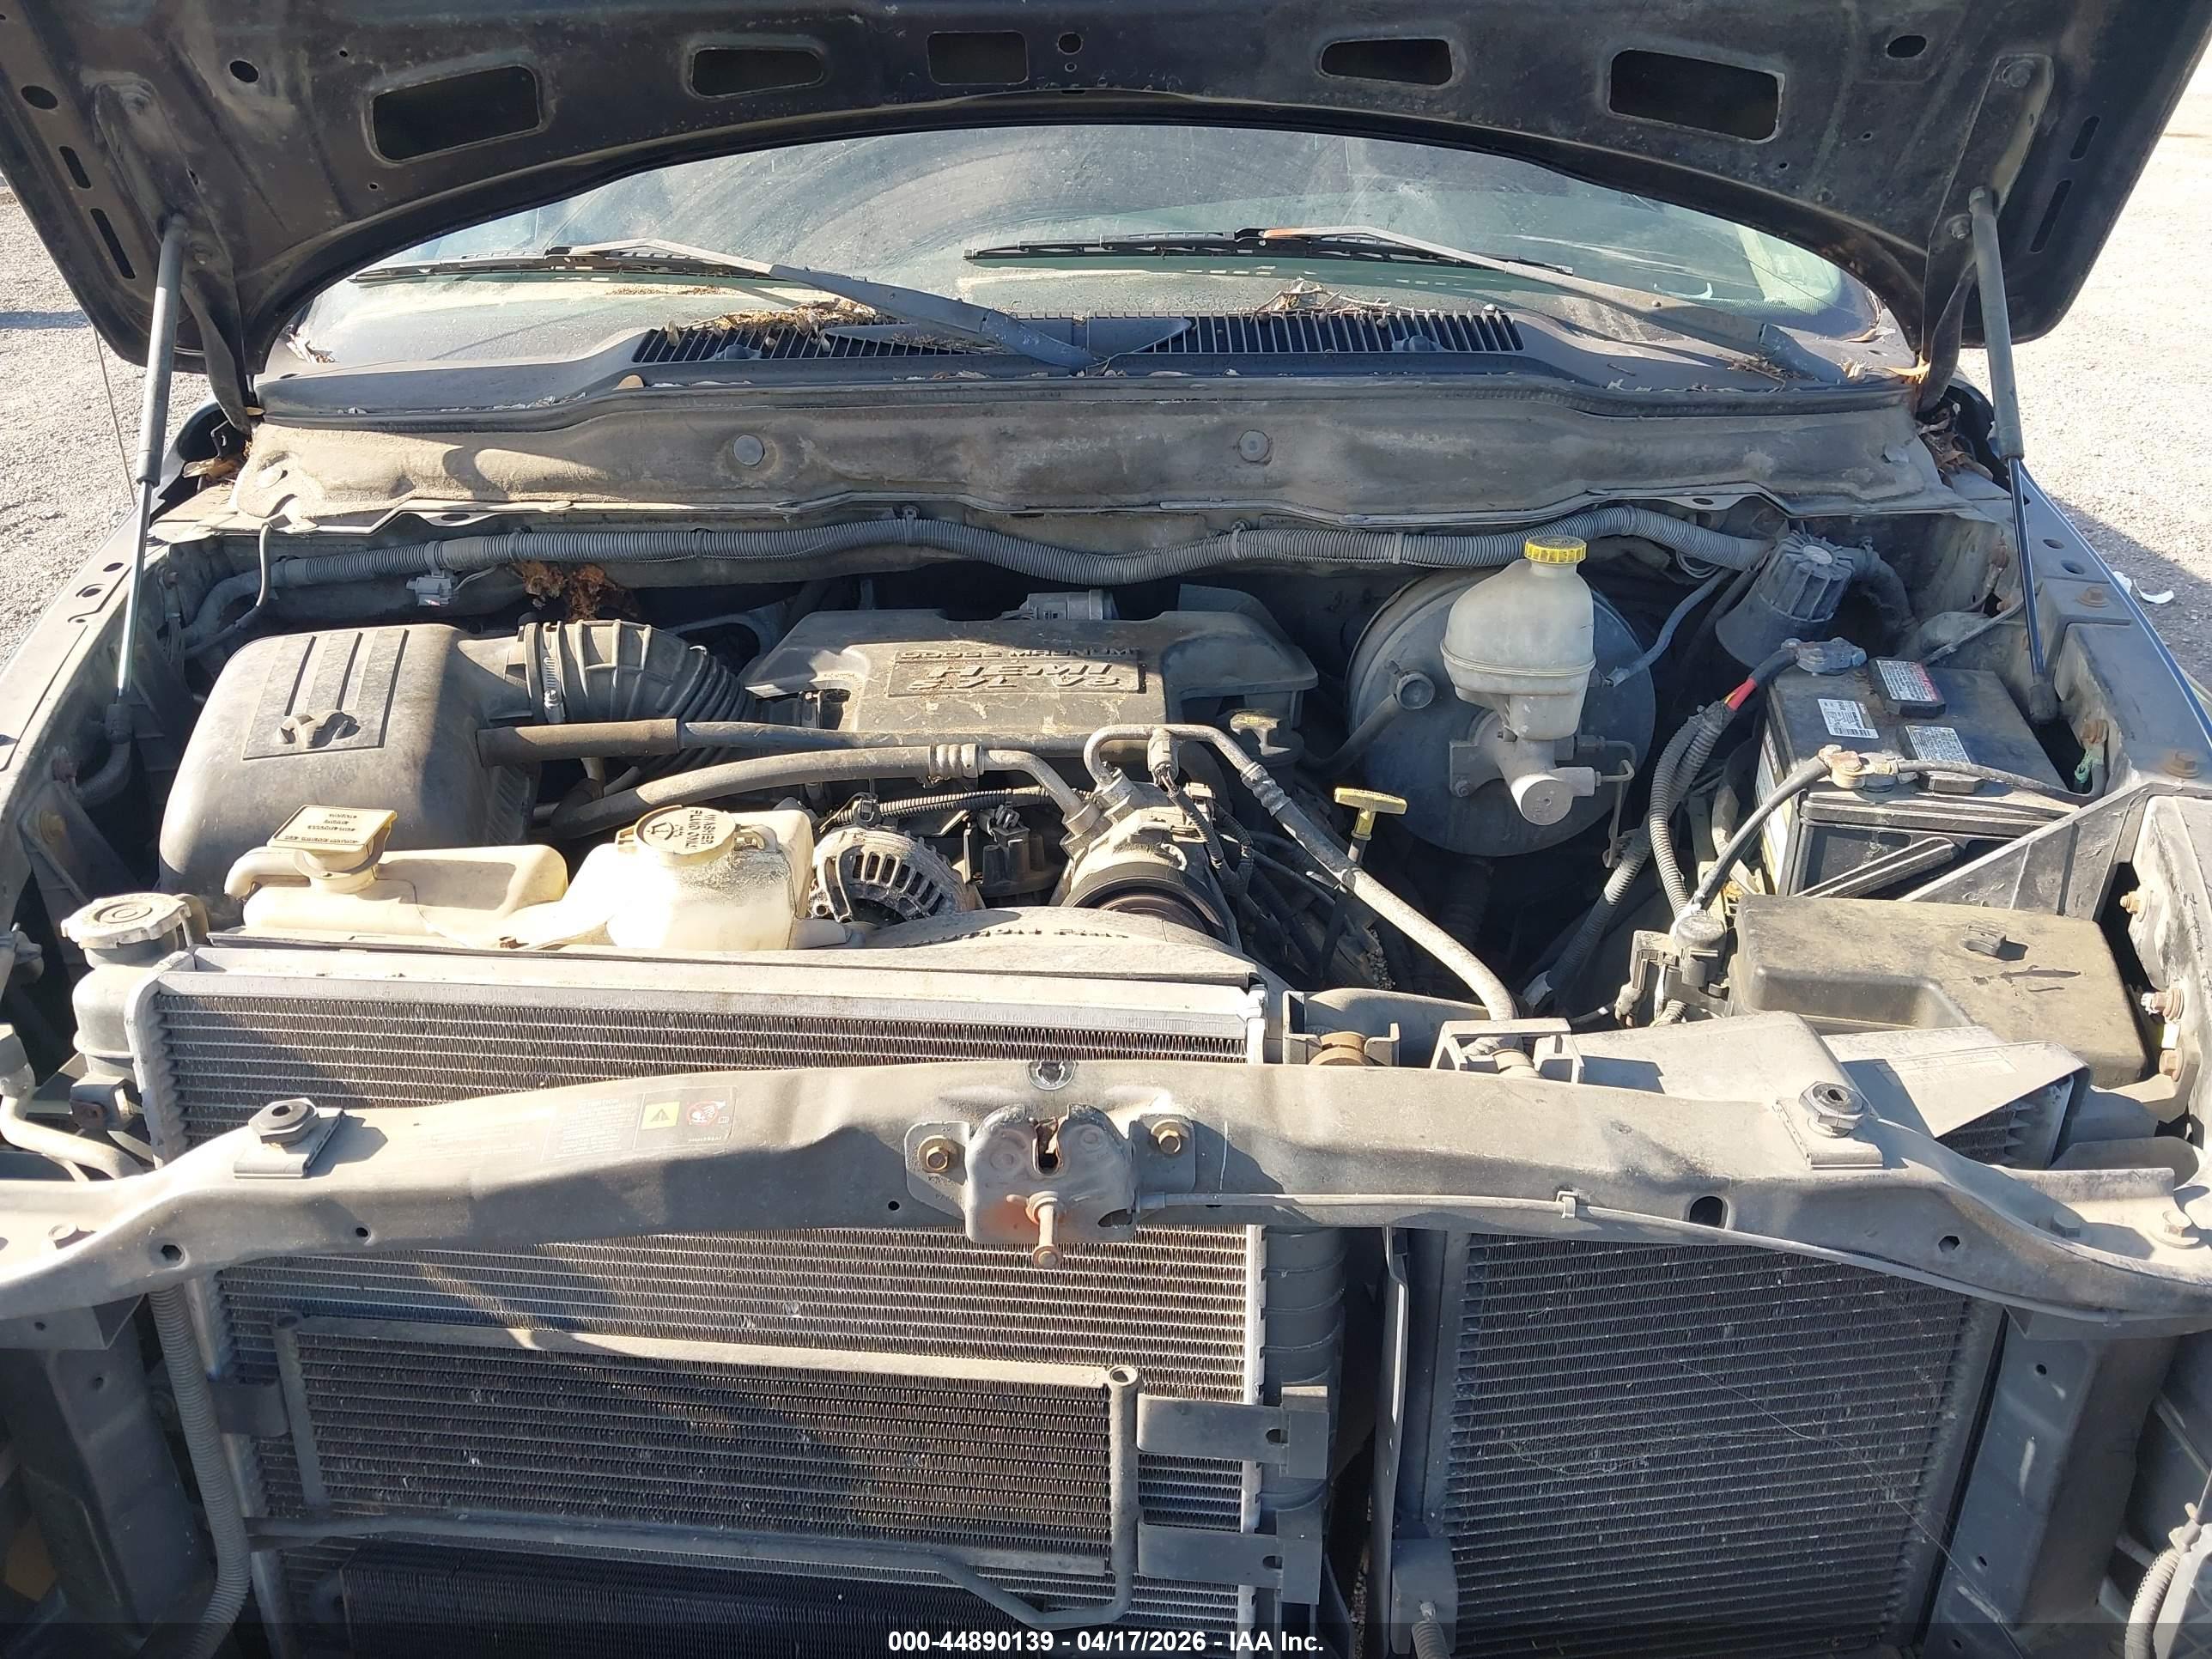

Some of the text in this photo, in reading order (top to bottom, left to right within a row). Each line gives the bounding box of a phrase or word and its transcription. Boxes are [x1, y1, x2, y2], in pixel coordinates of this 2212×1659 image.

[901, 650, 1003, 659] DODGE
[927, 663, 1114, 678] HEMI
[1051, 676, 1121, 688] V8
